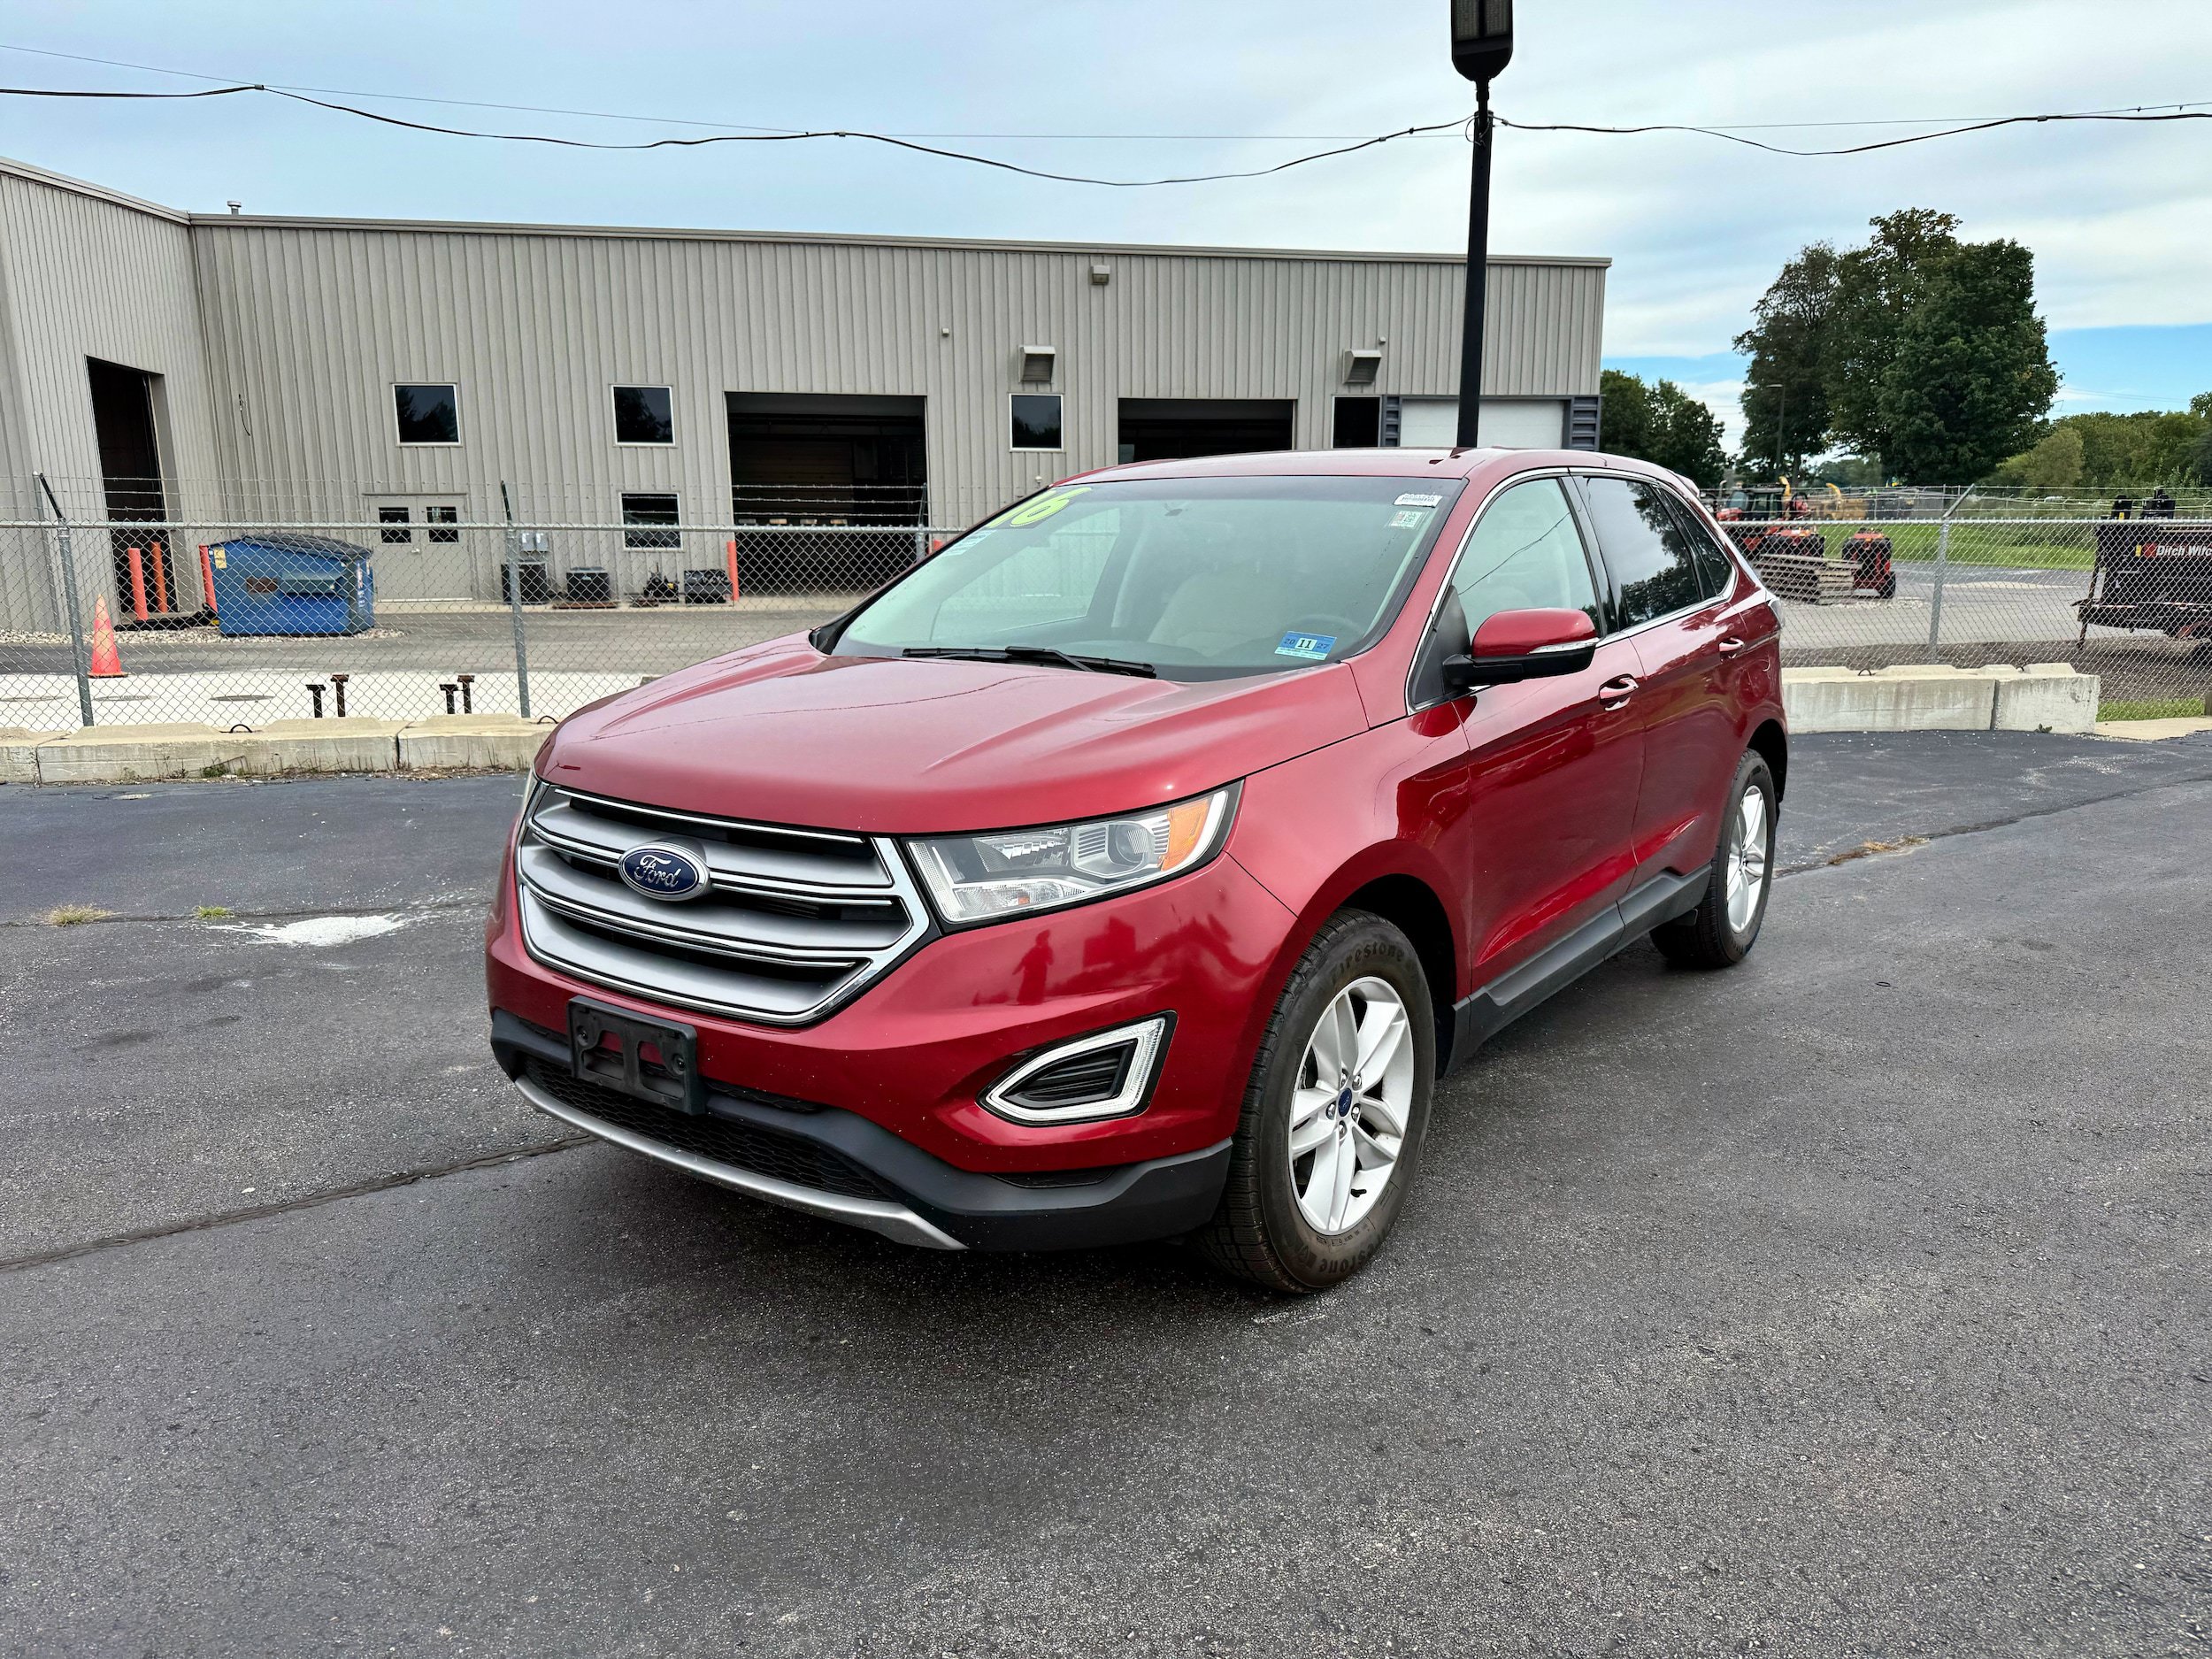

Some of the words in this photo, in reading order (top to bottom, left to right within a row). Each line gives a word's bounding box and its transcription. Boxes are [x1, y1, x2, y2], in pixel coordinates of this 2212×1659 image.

[2156, 545, 2185, 557] Ditch
[1297, 639, 1312, 649] 11
[634, 854, 682, 887] Ford
